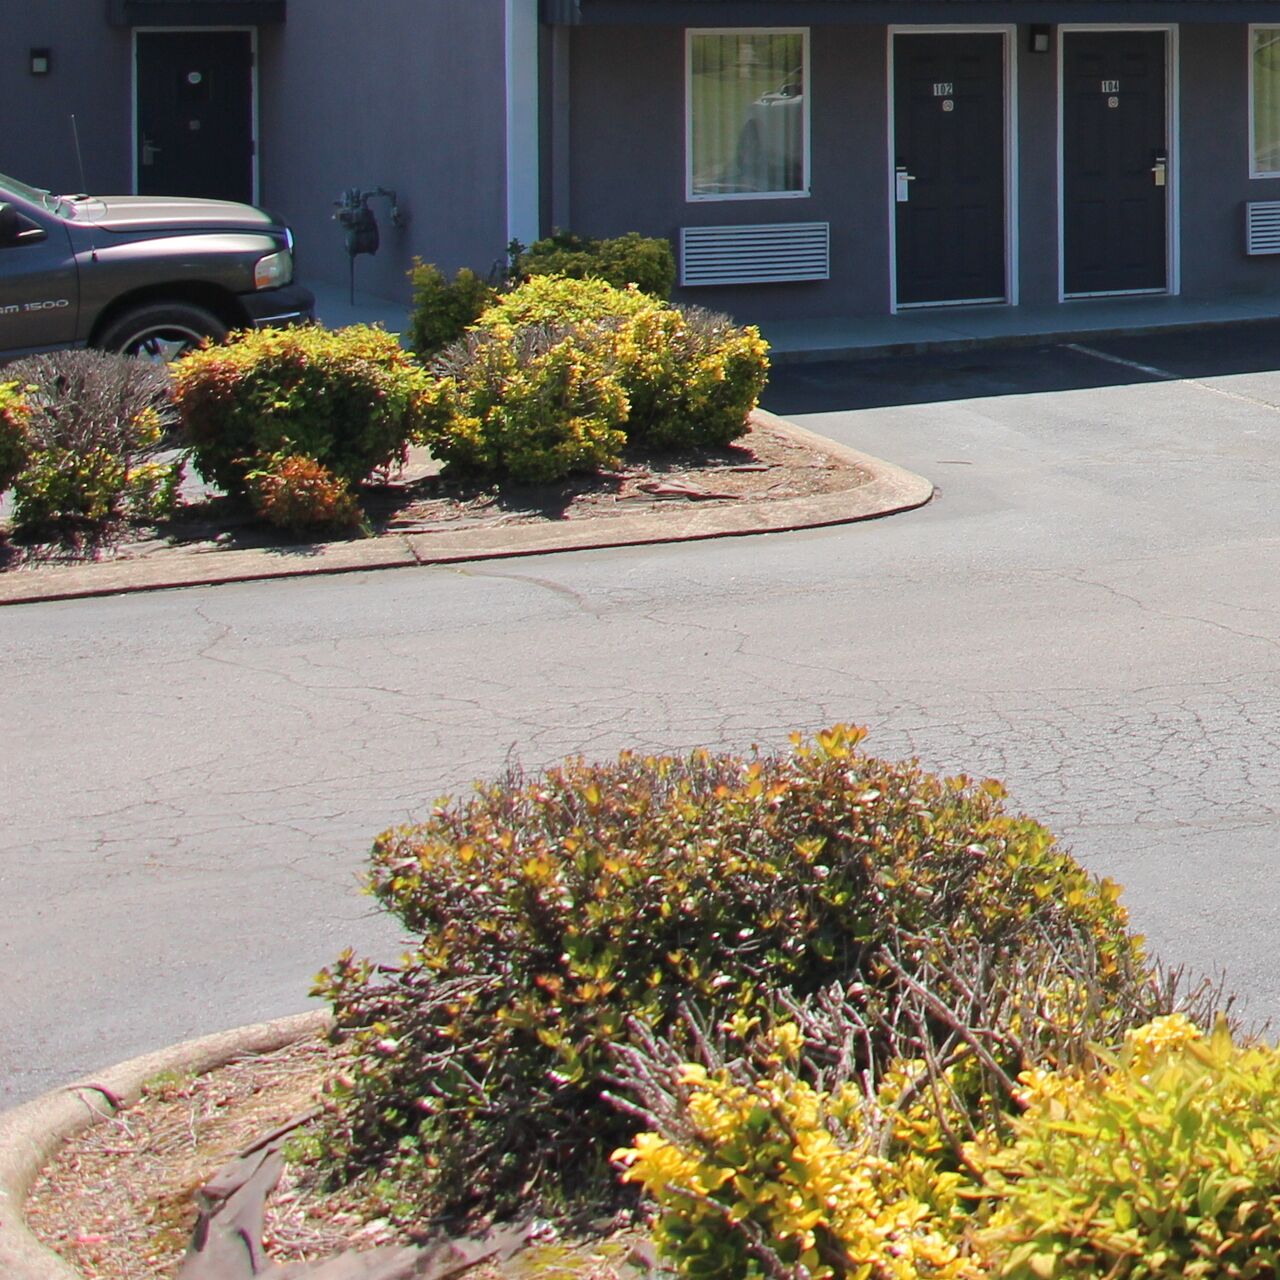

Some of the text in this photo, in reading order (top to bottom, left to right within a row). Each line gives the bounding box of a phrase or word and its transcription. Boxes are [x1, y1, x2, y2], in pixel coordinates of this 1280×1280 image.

[933, 82, 953, 96] 102
[1101, 80, 1120, 93] 104
[23, 299, 69, 312] 1500
